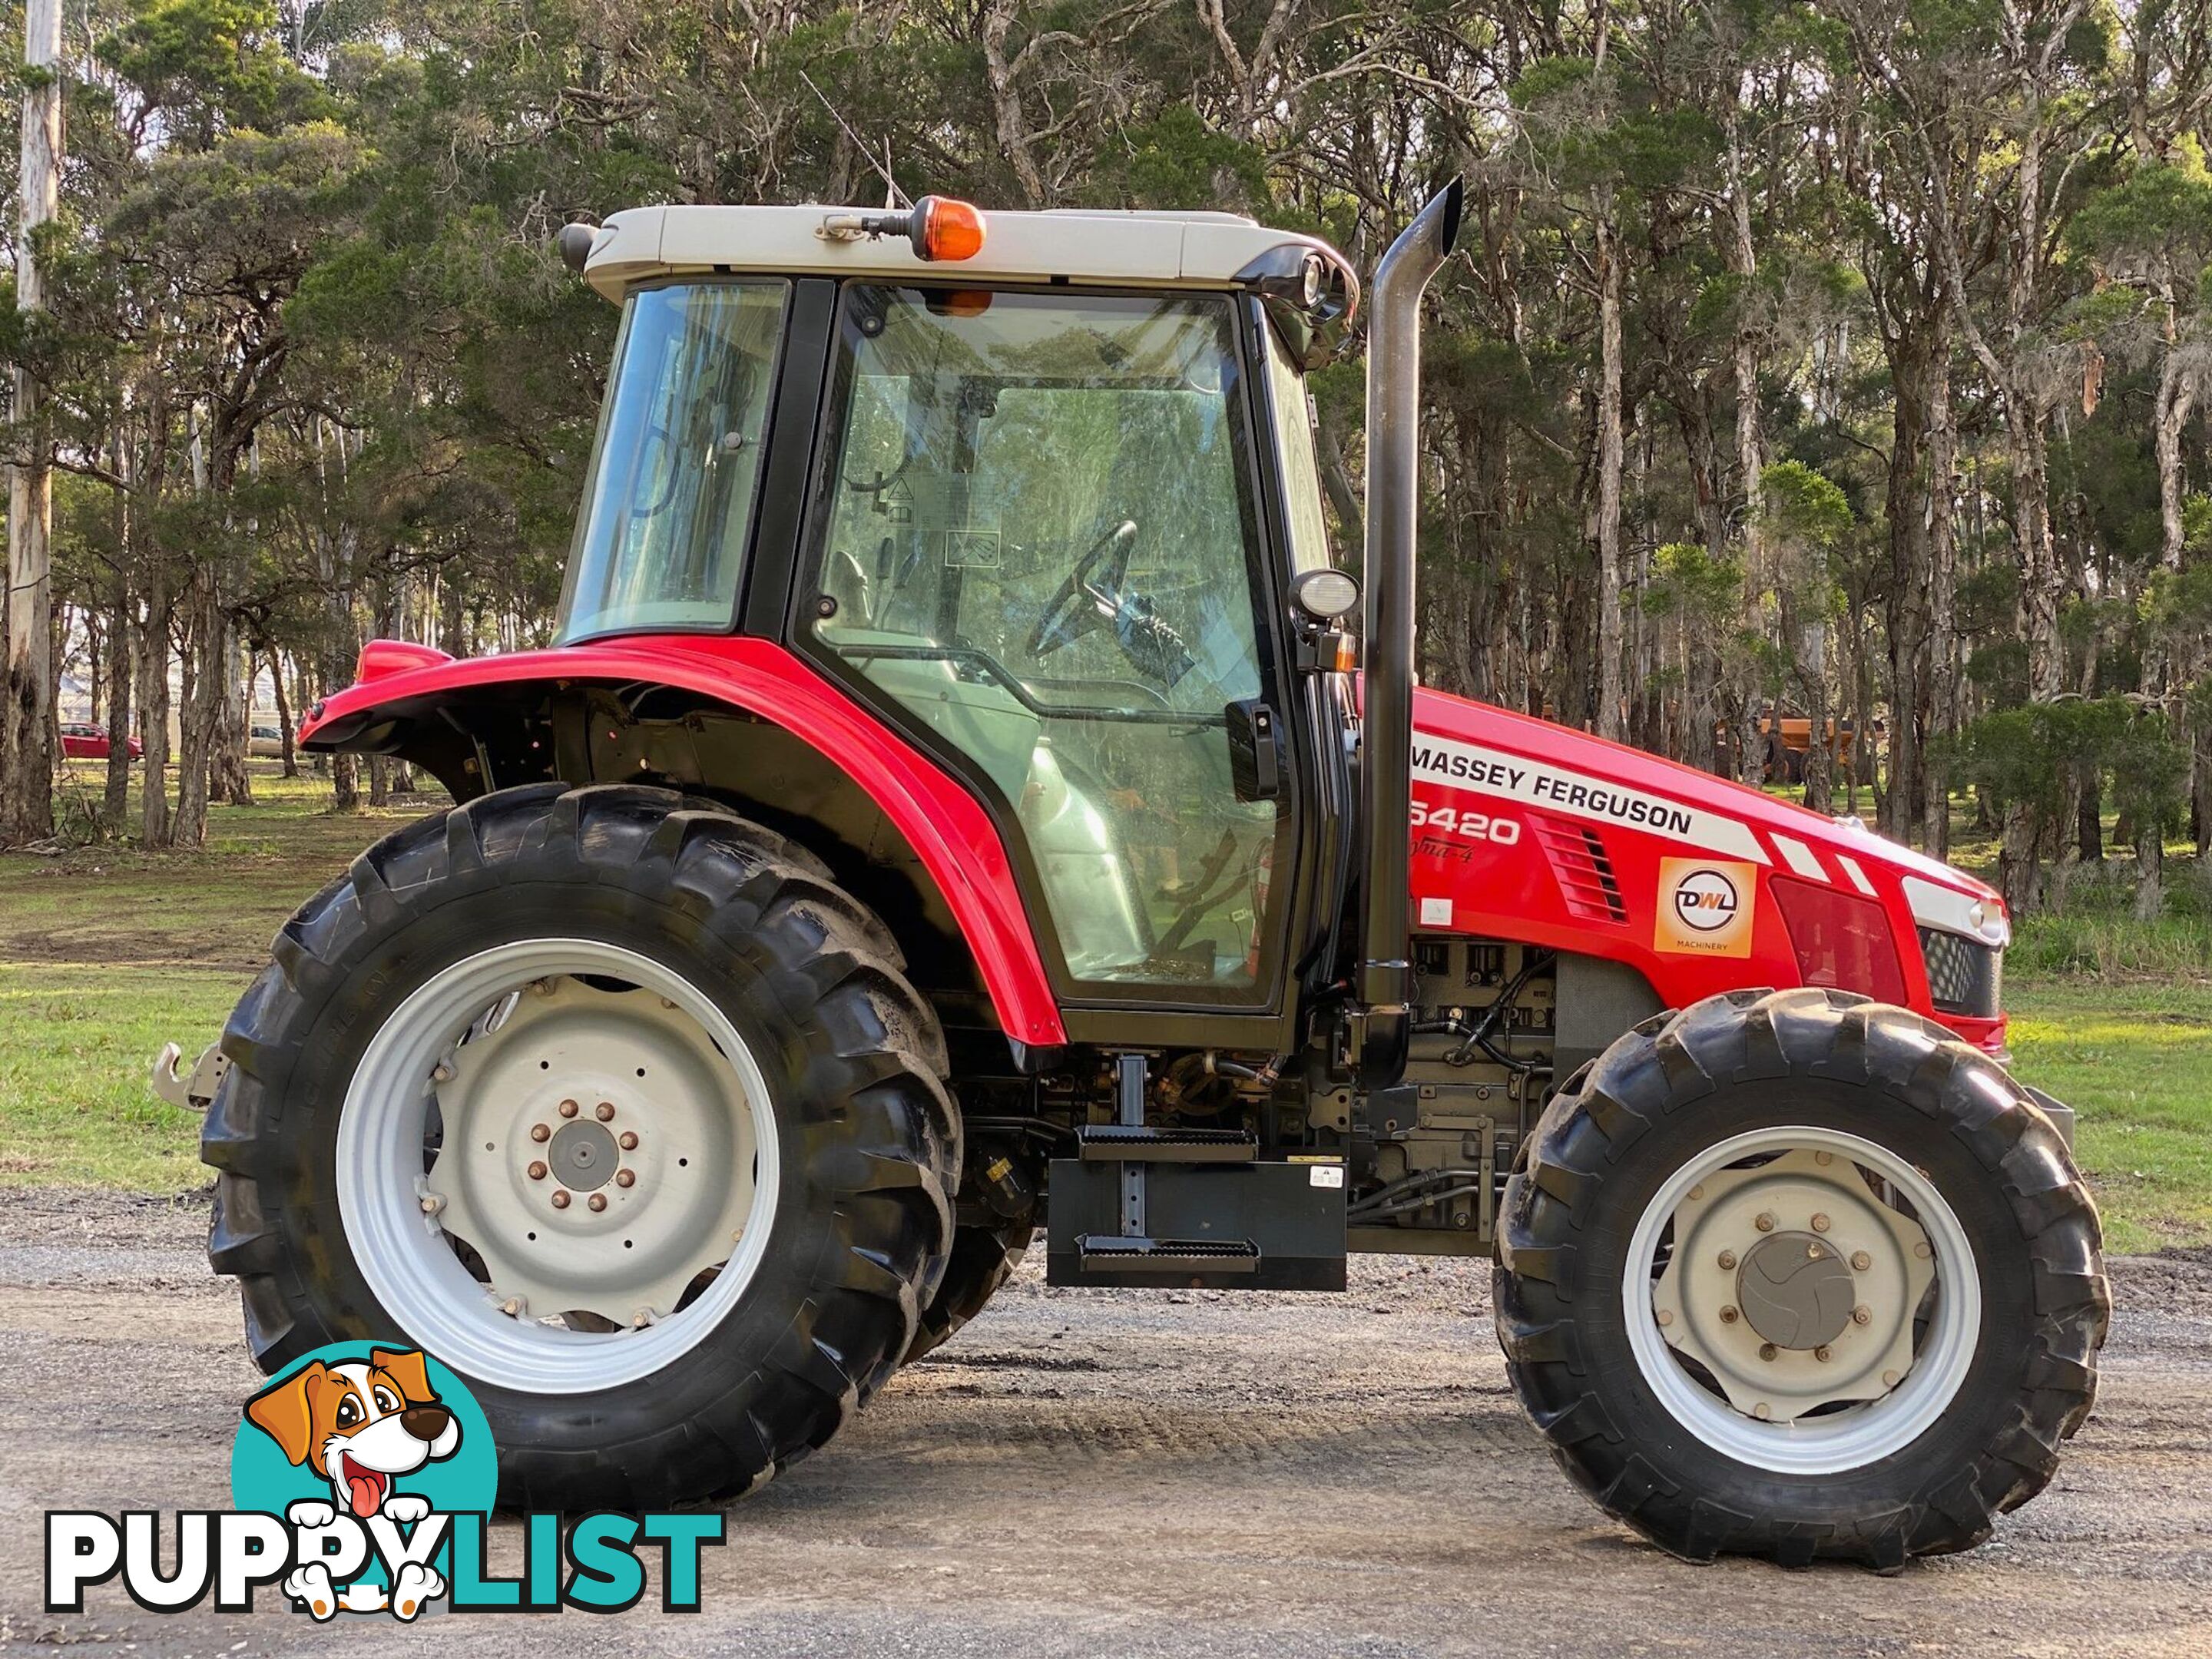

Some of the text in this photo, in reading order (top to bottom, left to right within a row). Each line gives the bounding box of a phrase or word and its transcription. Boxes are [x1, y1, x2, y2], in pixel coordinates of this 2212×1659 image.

[1412, 745, 1693, 835] MASSEY FERGUSON
[1677, 940, 1728, 951] MACHINERY
